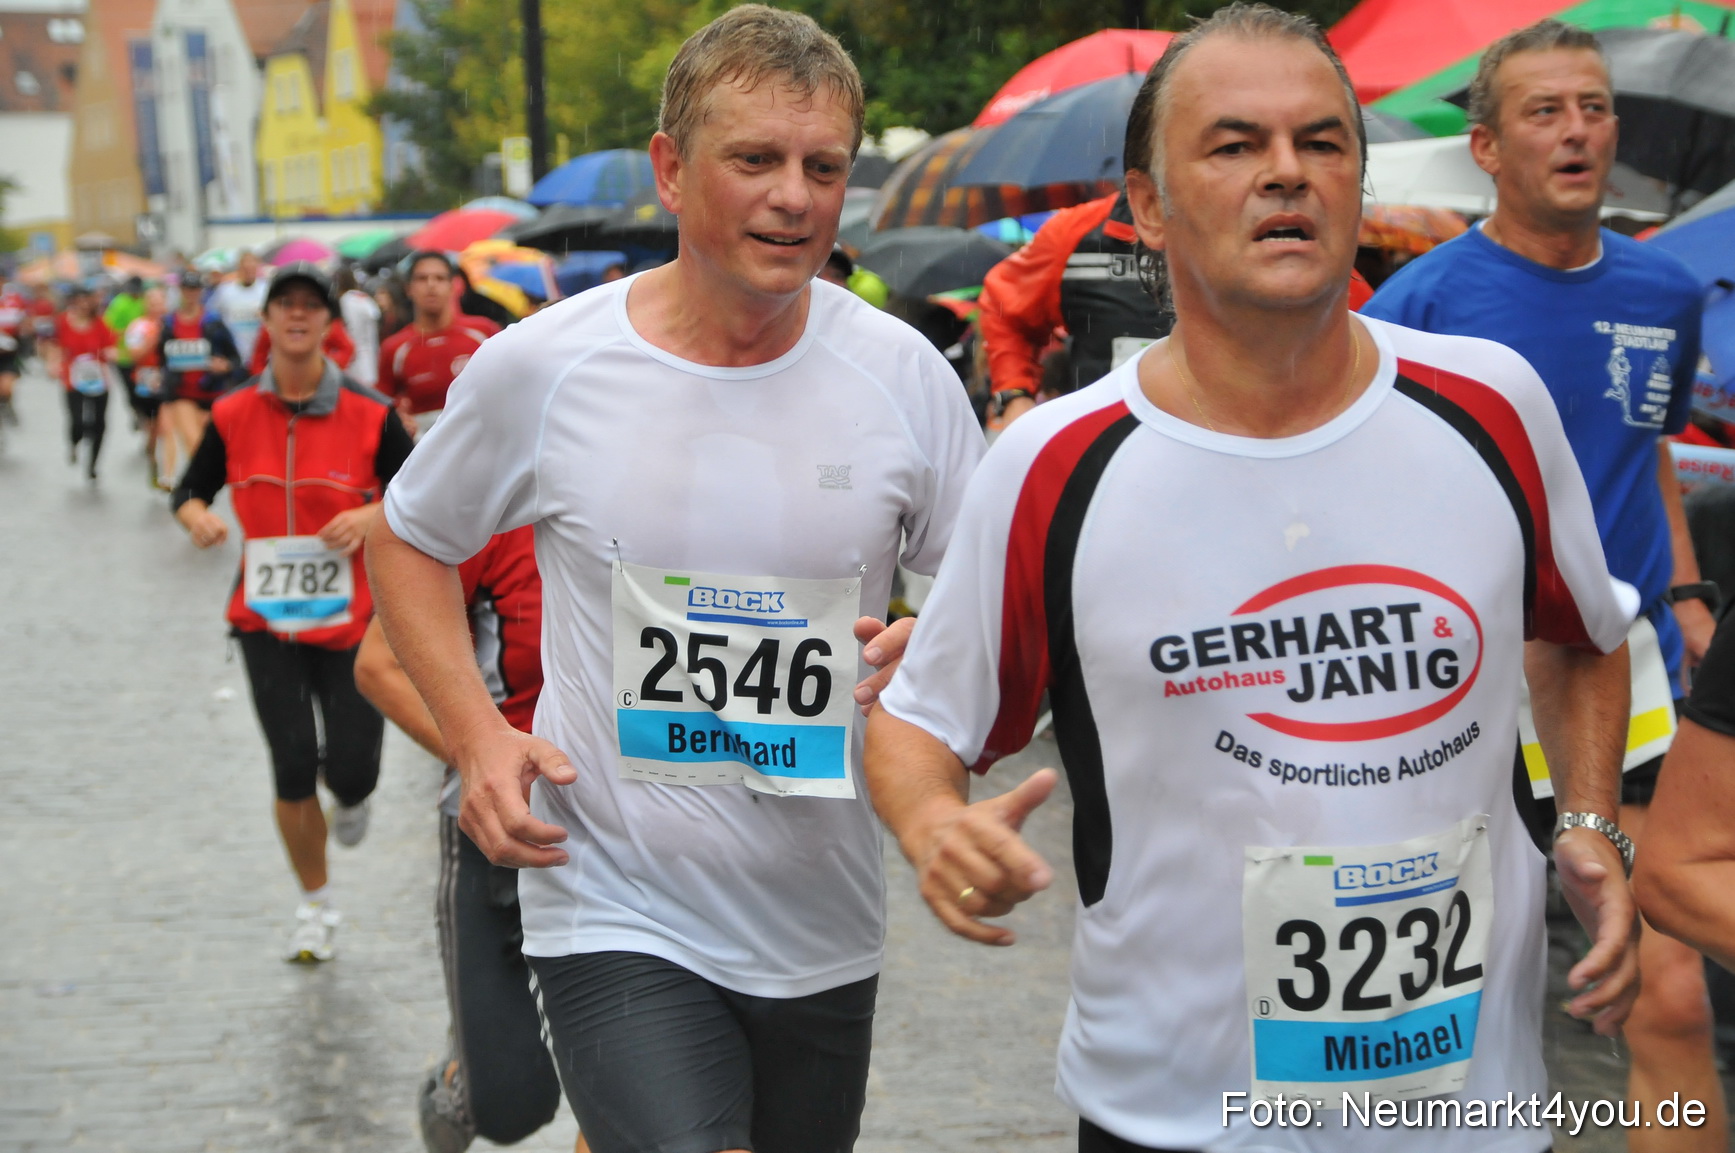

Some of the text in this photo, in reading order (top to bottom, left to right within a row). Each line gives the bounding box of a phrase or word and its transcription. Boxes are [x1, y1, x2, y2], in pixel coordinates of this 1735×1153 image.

[256, 561, 339, 596] 2782
[688, 587, 785, 613] BOCK
[1150, 603, 1453, 674] GERHART &
[640, 626, 833, 718] 2546
[1164, 669, 1286, 698] Autohaus
[1286, 648, 1460, 703] JÄNIG
[623, 692, 632, 706] C
[668, 722, 797, 768] Bernhard
[1214, 720, 1481, 786] Das sportliche Autohaus
[1334, 852, 1439, 889] BOCK
[1276, 890, 1484, 1012] 3232
[1259, 1000, 1270, 1016] D
[1323, 1014, 1463, 1071] Michael
